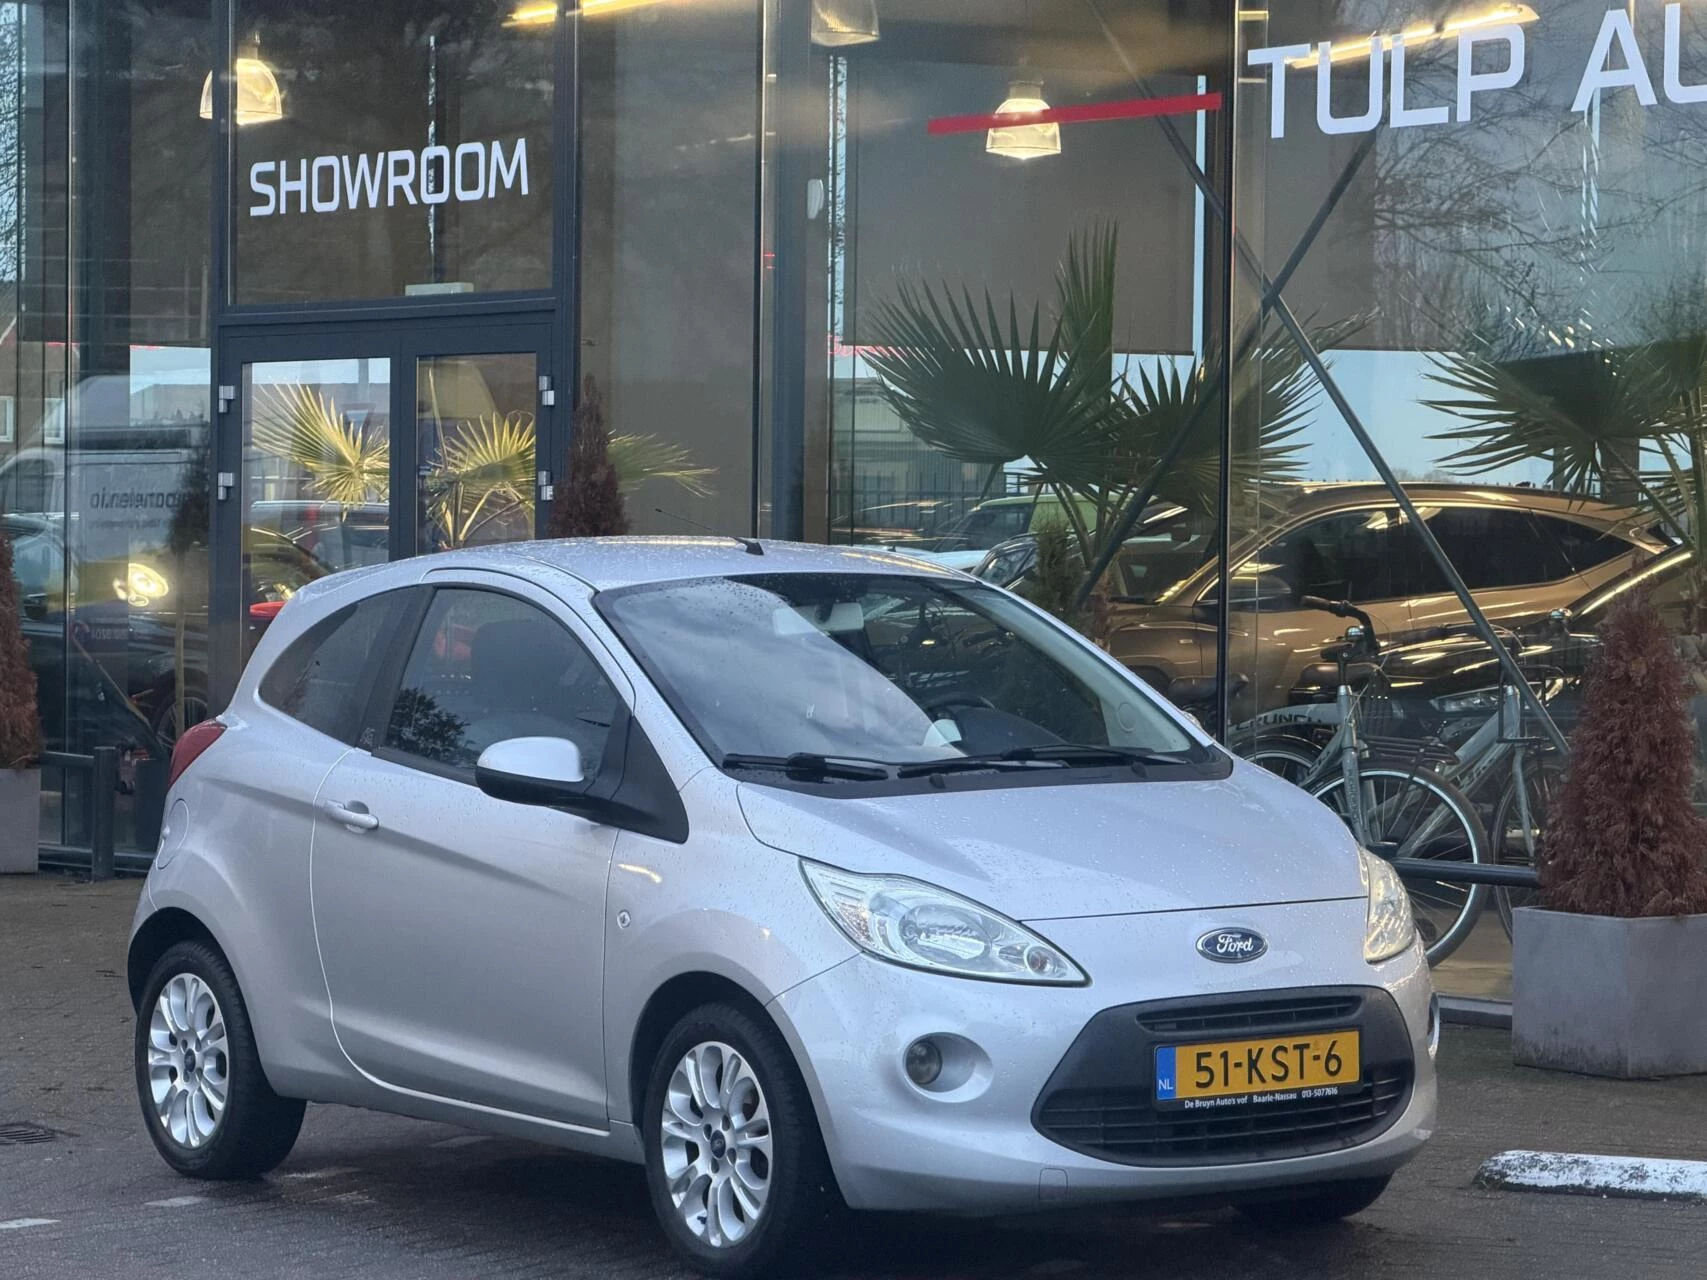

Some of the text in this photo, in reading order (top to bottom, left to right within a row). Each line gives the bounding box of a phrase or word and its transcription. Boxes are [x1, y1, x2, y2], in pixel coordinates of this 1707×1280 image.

[1248, 3, 1707, 139] TULP AU
[250, 138, 529, 216] SHOWROOM
[1216, 933, 1254, 953] Ford
[1195, 1040, 1343, 1089] 51-KST-6
[1158, 1078, 1174, 1091] NL
[1184, 1100, 1195, 1109] De
[1195, 1099, 1215, 1109] Bruyn
[1216, 1097, 1236, 1106] Auto's
[1237, 1095, 1248, 1104] vof
[1253, 1092, 1297, 1103] Baarle-Nassau
